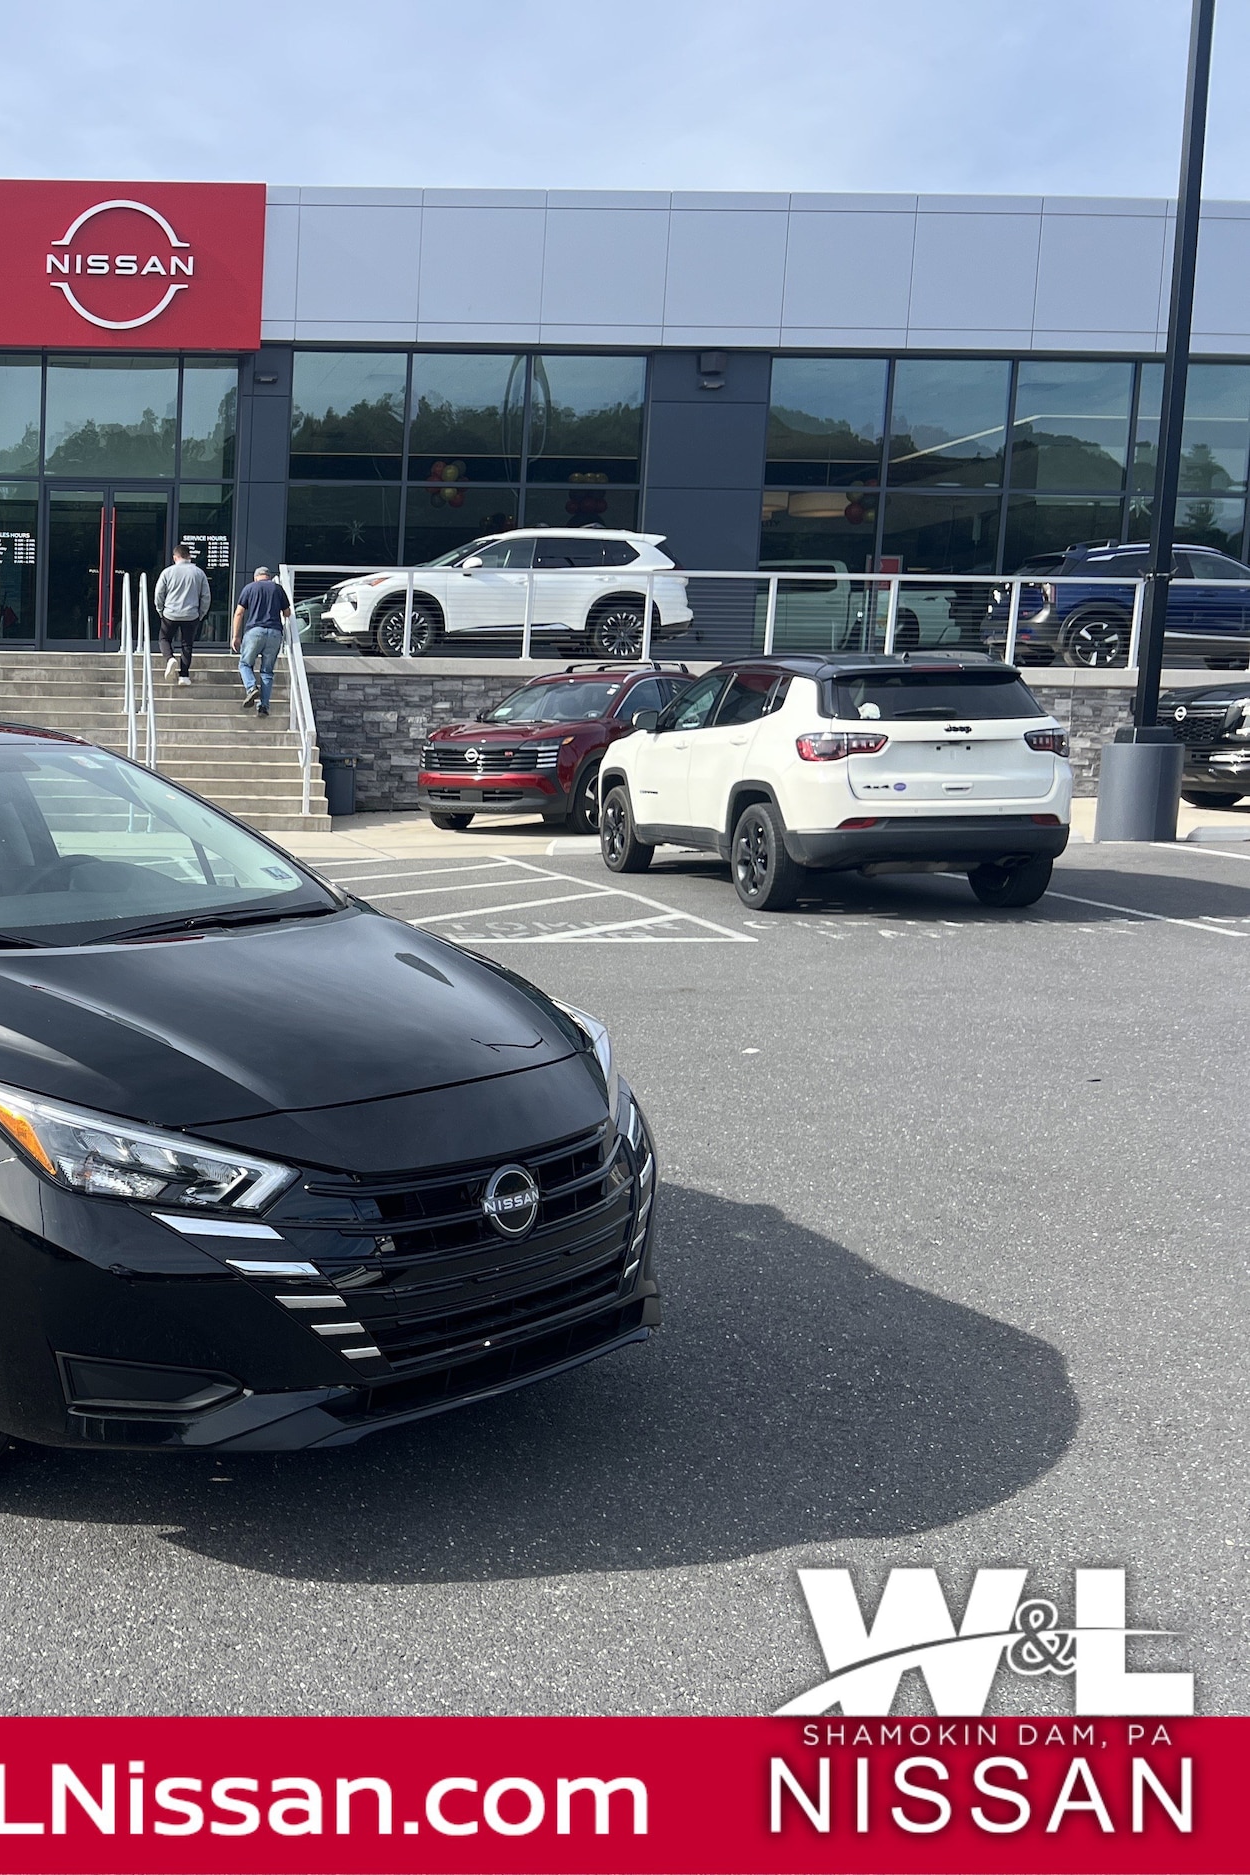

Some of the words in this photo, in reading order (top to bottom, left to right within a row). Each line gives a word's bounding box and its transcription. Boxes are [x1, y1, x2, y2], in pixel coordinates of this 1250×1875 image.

[46, 254, 194, 276] NISSAN
[944, 723, 972, 734] Jeep
[484, 1190, 540, 1213] NISSAN
